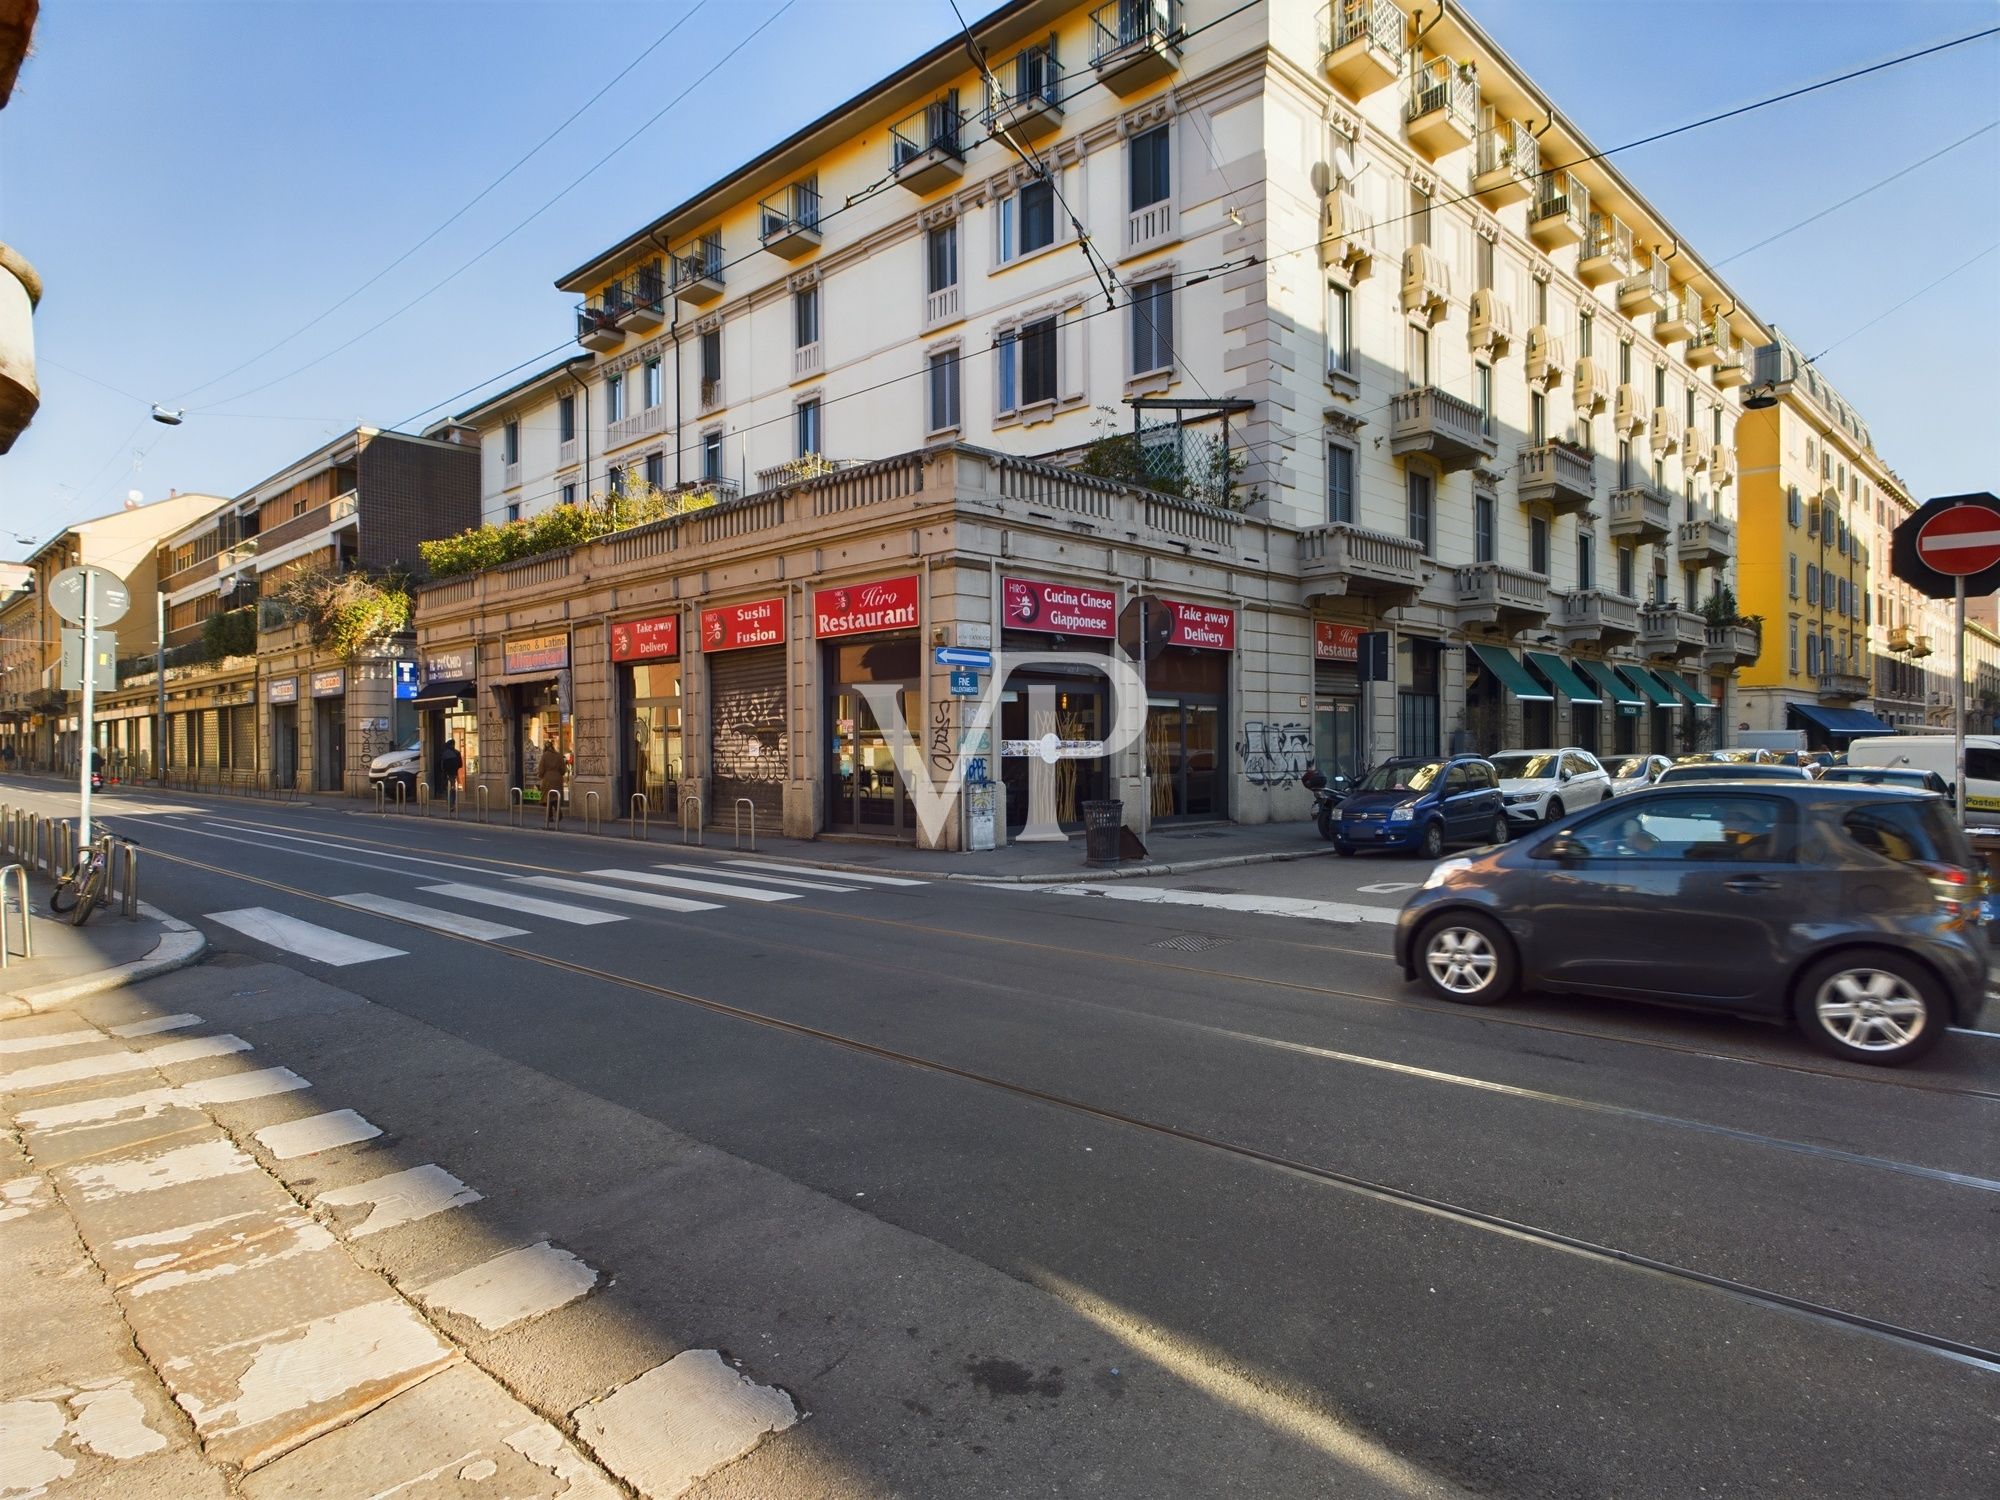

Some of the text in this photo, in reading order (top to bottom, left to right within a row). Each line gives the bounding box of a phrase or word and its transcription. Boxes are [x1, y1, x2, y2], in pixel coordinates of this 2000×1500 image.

[1009, 583, 1026, 594] HIRO
[859, 586, 897, 608] Hiro
[1044, 588, 1112, 610] Cucina Cinese
[705, 613, 718, 622] HIRO
[737, 605, 771, 621] Sushi
[819, 603, 915, 633] Restaurant
[1050, 610, 1107, 630] Giapponese
[1178, 606, 1230, 628] Take away
[636, 621, 672, 634] Take away
[737, 630, 776, 644] Fusion
[1184, 627, 1224, 646] Delivery
[1338, 628, 1357, 644] Hir
[507, 636, 566, 653] Indiano & Latino
[640, 642, 668, 653] Delivery
[958, 677, 970, 686] FINE
